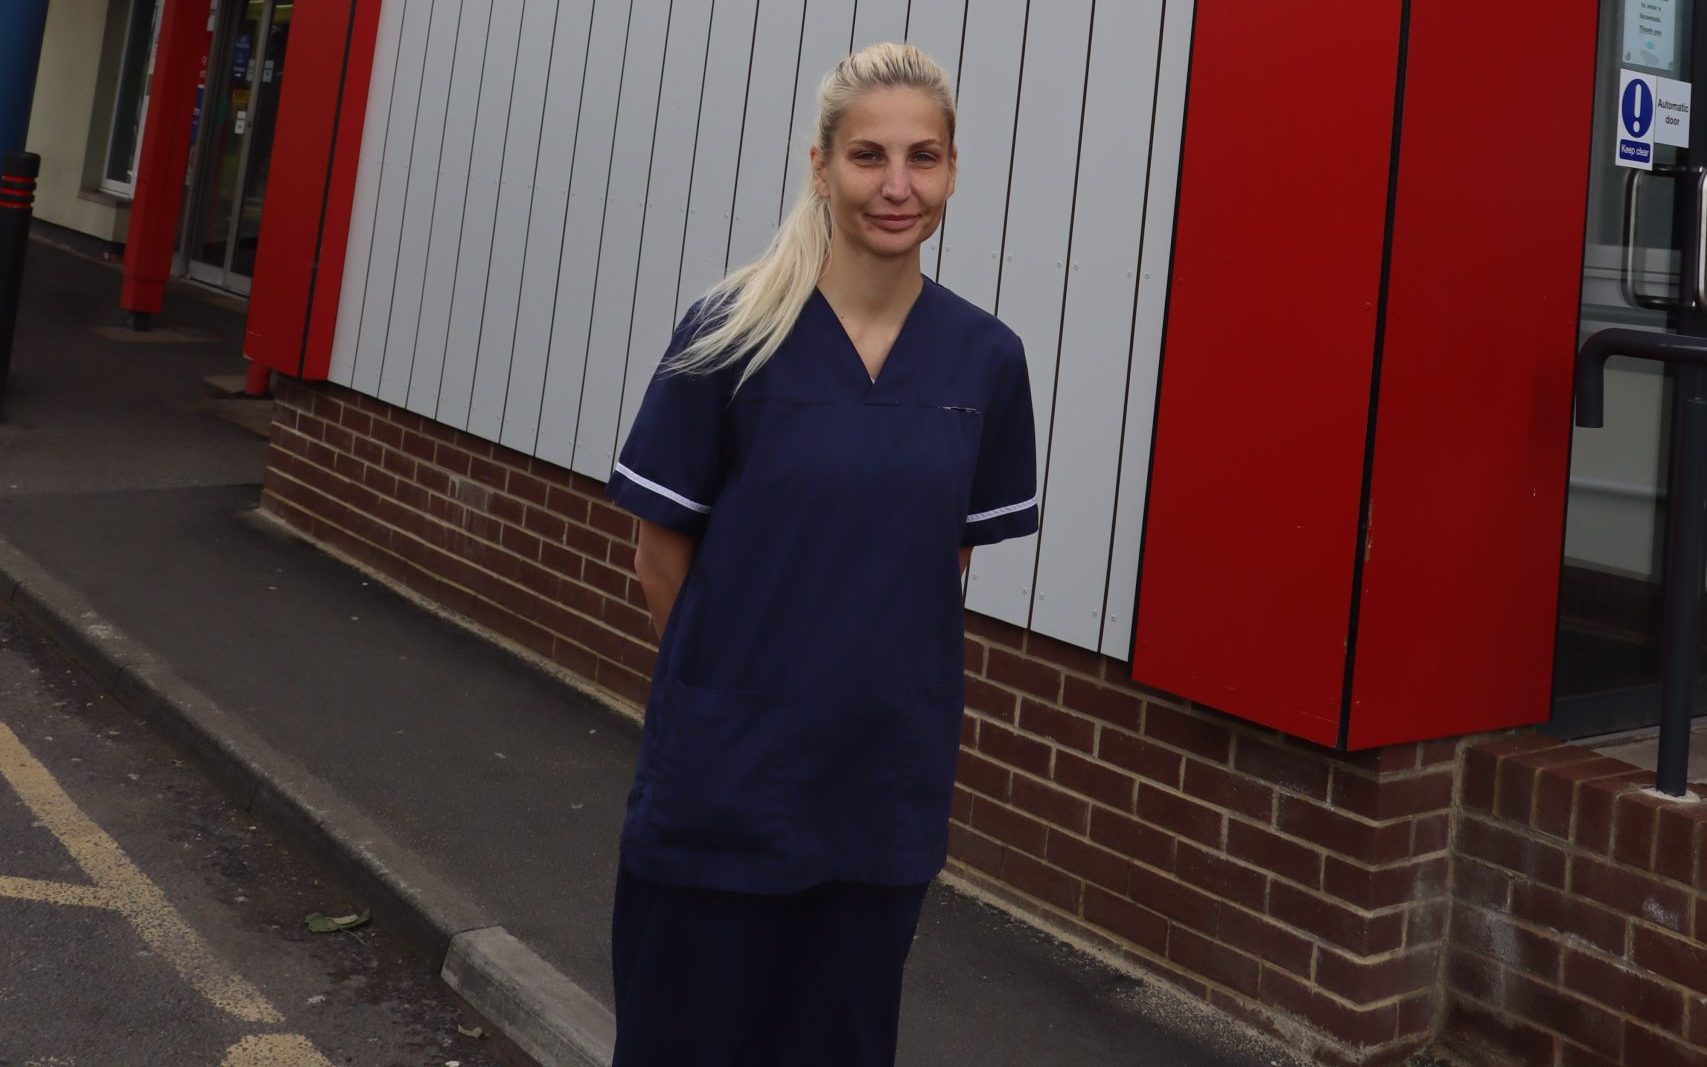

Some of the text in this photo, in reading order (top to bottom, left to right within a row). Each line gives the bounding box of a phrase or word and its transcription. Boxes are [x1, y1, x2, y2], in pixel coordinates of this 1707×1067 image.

[1658, 98, 1689, 113] Automatic
[1665, 115, 1680, 126] door
[1621, 144, 1649, 157] Keep clear
